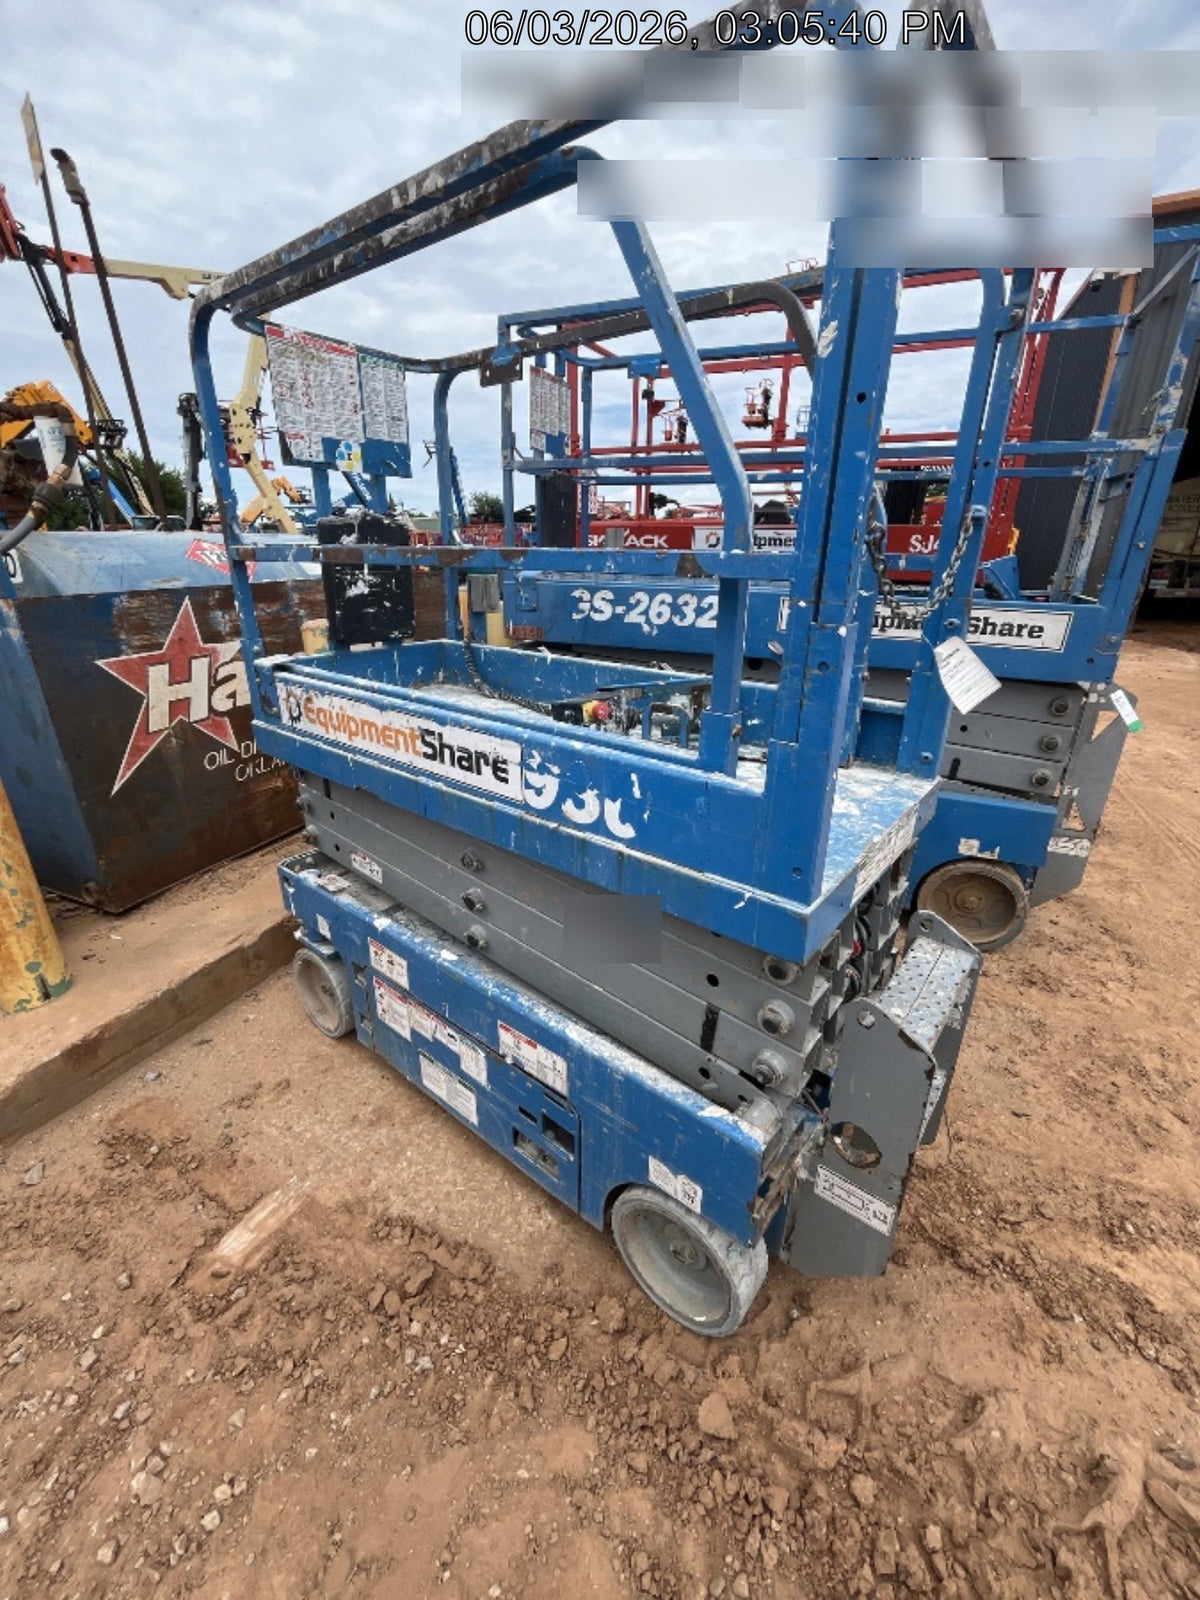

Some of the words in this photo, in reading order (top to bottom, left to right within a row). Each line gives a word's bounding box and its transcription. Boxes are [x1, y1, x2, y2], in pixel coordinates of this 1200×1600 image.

[588, 528, 669, 548] SKACK
[303, 696, 510, 784] EquipmentShare
[204, 747, 236, 770] OIL
